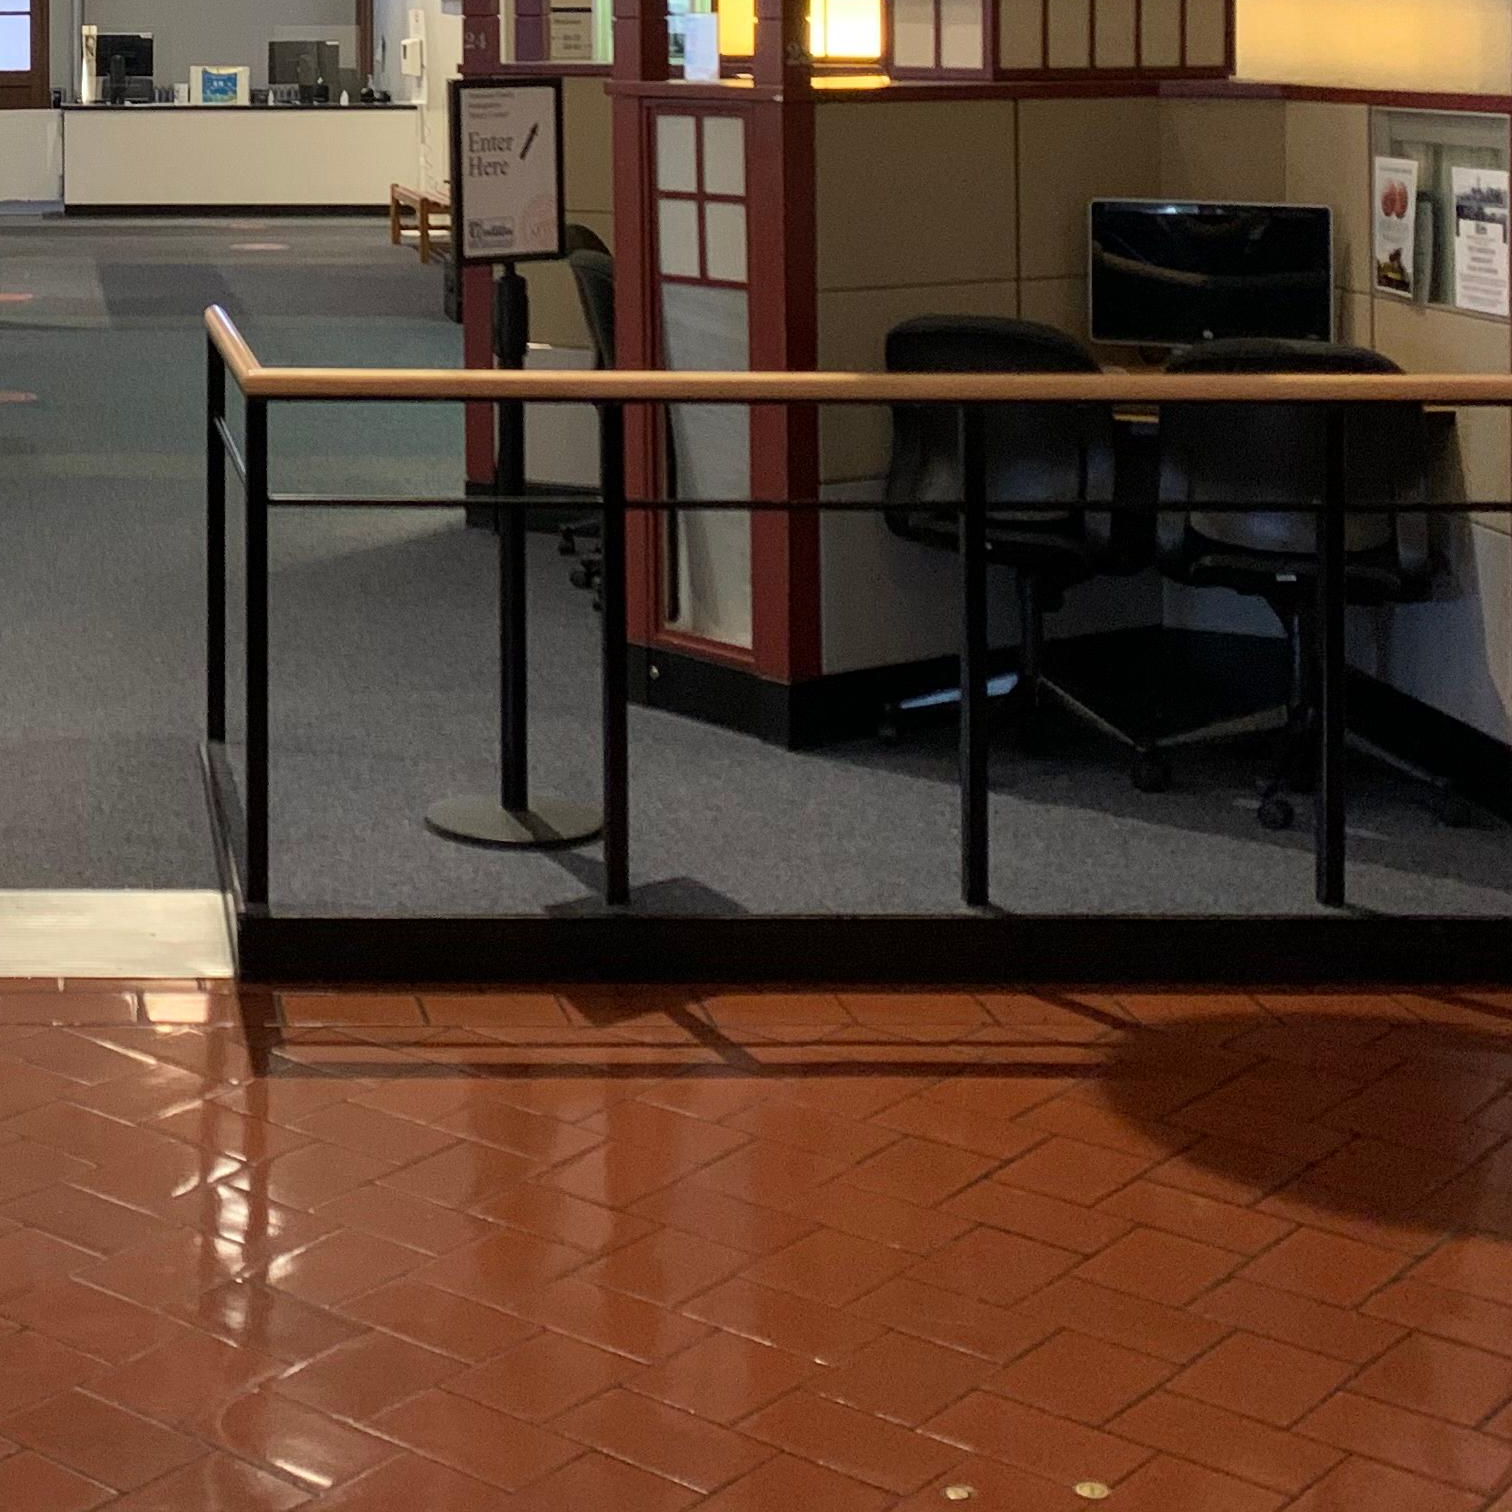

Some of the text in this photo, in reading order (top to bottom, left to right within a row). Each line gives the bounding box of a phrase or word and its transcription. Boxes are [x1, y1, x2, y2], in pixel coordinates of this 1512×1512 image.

[464, 31, 487, 50] 24
[468, 131, 514, 153] Enter
[468, 155, 510, 177] Here
